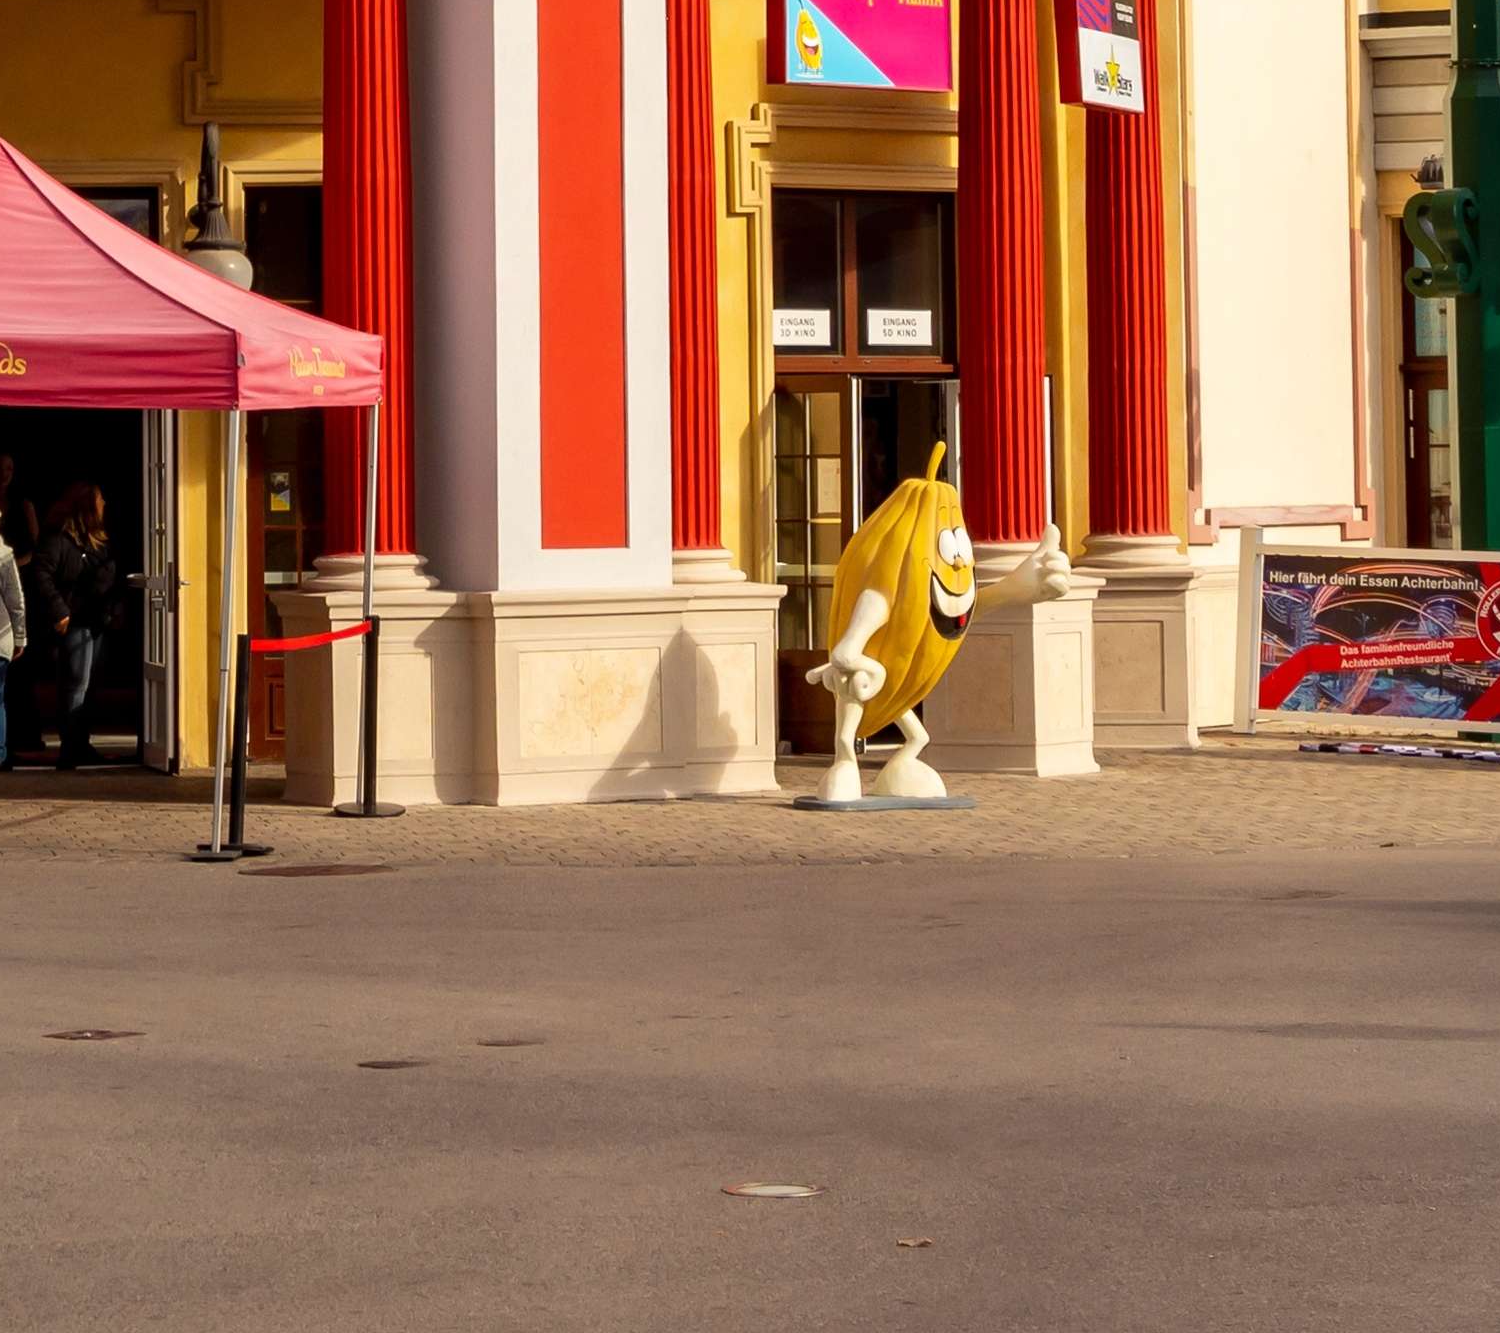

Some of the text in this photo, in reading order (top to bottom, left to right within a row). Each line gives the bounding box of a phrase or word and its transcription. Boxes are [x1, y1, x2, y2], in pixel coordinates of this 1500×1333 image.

[780, 317, 816, 327] EINGANG
[883, 317, 917, 327] EINGANG
[795, 328, 816, 338] KINO
[896, 328, 917, 338] KINO
[1269, 571, 1479, 591] Hier fährt dein Essen Achterbahn!
[1340, 640, 1454, 656] Das familienfreundliche
[1341, 653, 1451, 670] AchterbahnRestaurant
